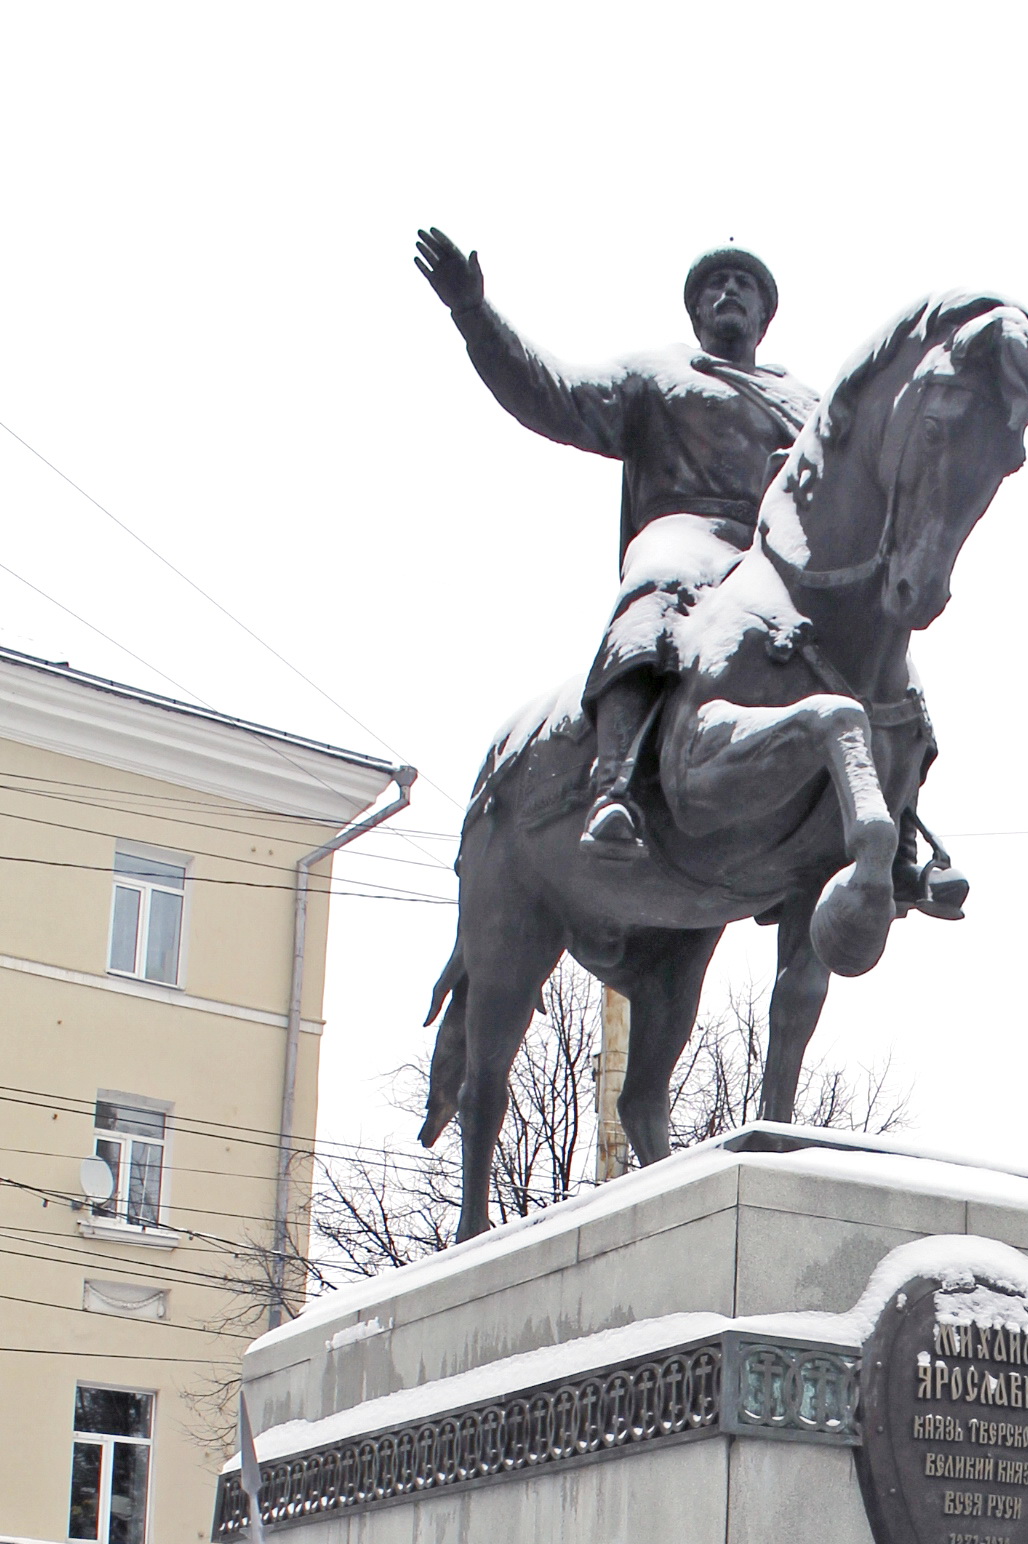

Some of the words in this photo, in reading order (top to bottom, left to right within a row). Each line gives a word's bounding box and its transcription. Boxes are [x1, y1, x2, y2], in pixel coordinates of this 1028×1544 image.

[914, 1415, 963, 1441] КНЯЗЬ
[926, 1452, 994, 1480] ВЕЛИКИЙ
[944, 1491, 982, 1516] ВСЕЯ
[988, 1494, 1022, 1519] РУСИ
